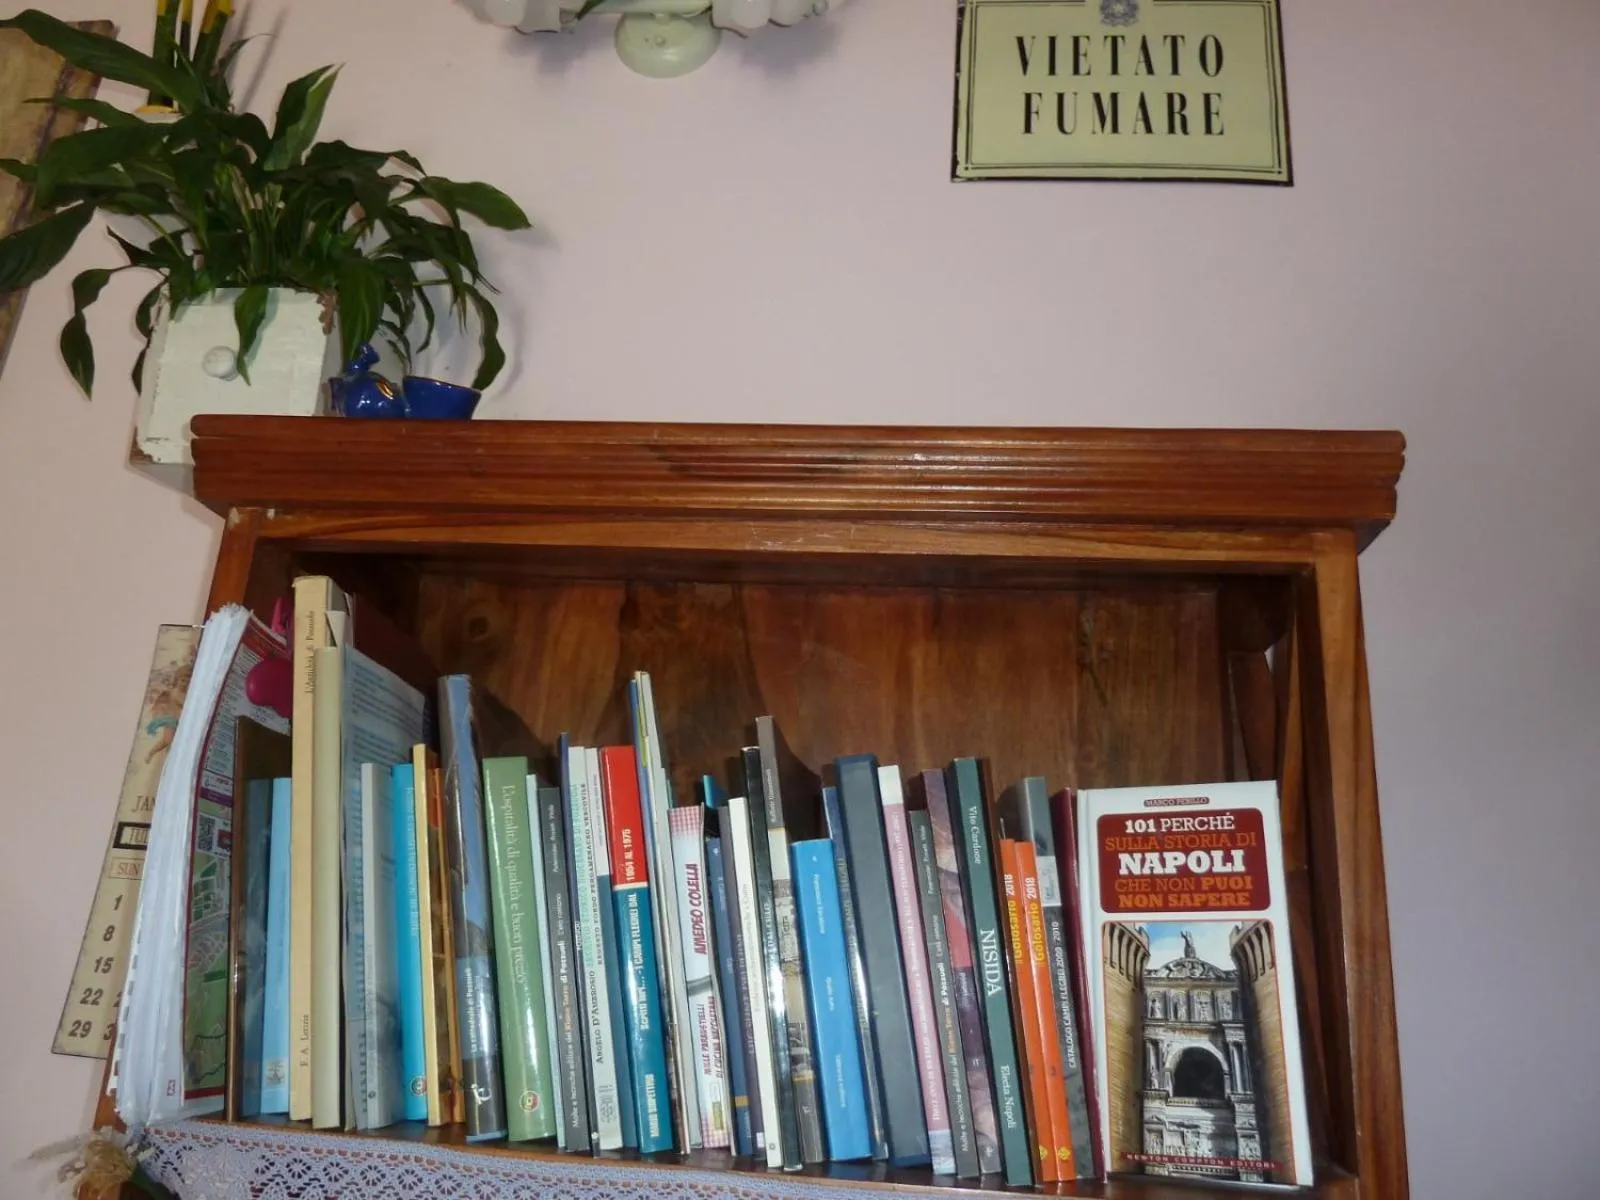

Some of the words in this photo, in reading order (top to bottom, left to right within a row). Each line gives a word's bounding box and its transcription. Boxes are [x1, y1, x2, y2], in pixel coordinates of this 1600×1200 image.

[1015, 34, 1224, 77] VIETATO
[1022, 92, 1225, 135] FUMARE
[968, 805, 978, 824] Vito
[1125, 819, 1157, 833] 101
[1159, 812, 1235, 832] PERCHÉ
[507, 845, 520, 858] di
[969, 825, 983, 865] Cardone
[1104, 835, 1159, 850] SULLA
[1164, 834, 1233, 850] STORIA
[1236, 832, 1256, 846] DI
[624, 849, 633, 859] AL
[1118, 850, 1246, 876] NAPOLI
[117, 862, 139, 876] SUN
[505, 859, 522, 900] qualità
[686, 862, 702, 906] COLELLA
[1005, 873, 1015, 896] 2018
[1025, 876, 1037, 900] 2018
[1114, 878, 1150, 893] CHE
[1156, 877, 1195, 892] NON
[1201, 876, 1253, 890] PUOI
[113, 895, 124, 911] 1
[628, 892, 637, 907] DAL
[1118, 894, 1165, 908] NON
[1168, 892, 1250, 908] SAPERE
[103, 925, 115, 942] 8
[512, 912, 524, 942] buon
[691, 908, 707, 955] AMEDEO
[1052, 921, 1060, 940] 2010
[93, 956, 114, 974] 15
[558, 941, 568, 974] Pozzuoli
[978, 926, 1003, 996] NISIDA
[560, 975, 568, 984] di
[937, 961, 948, 995] Pozzuoli
[1058, 967, 1068, 999] FLEGREI
[79, 987, 104, 1006] 22
[942, 995, 949, 1005] di
[943, 1006, 953, 1028] Terra
[1062, 1000, 1071, 1025] CAMPI
[68, 1019, 93, 1038] 29
[713, 1041, 722, 1069] CUCINA
[1066, 1026, 1077, 1068] CATALOGO
[703, 1054, 711, 1075] MILLE
[948, 1054, 958, 1067] del
[715, 1070, 724, 1078] DI
[1000, 1064, 1012, 1094] Electa
[955, 1094, 965, 1123] tecniche
[1002, 1095, 1016, 1129] Napoli
[960, 1130, 969, 1151] Malte
[1126, 1154, 1168, 1162] NEWTON
[1174, 1157, 1224, 1166] COMPTON
[1230, 1160, 1275, 1168] EDITORI
